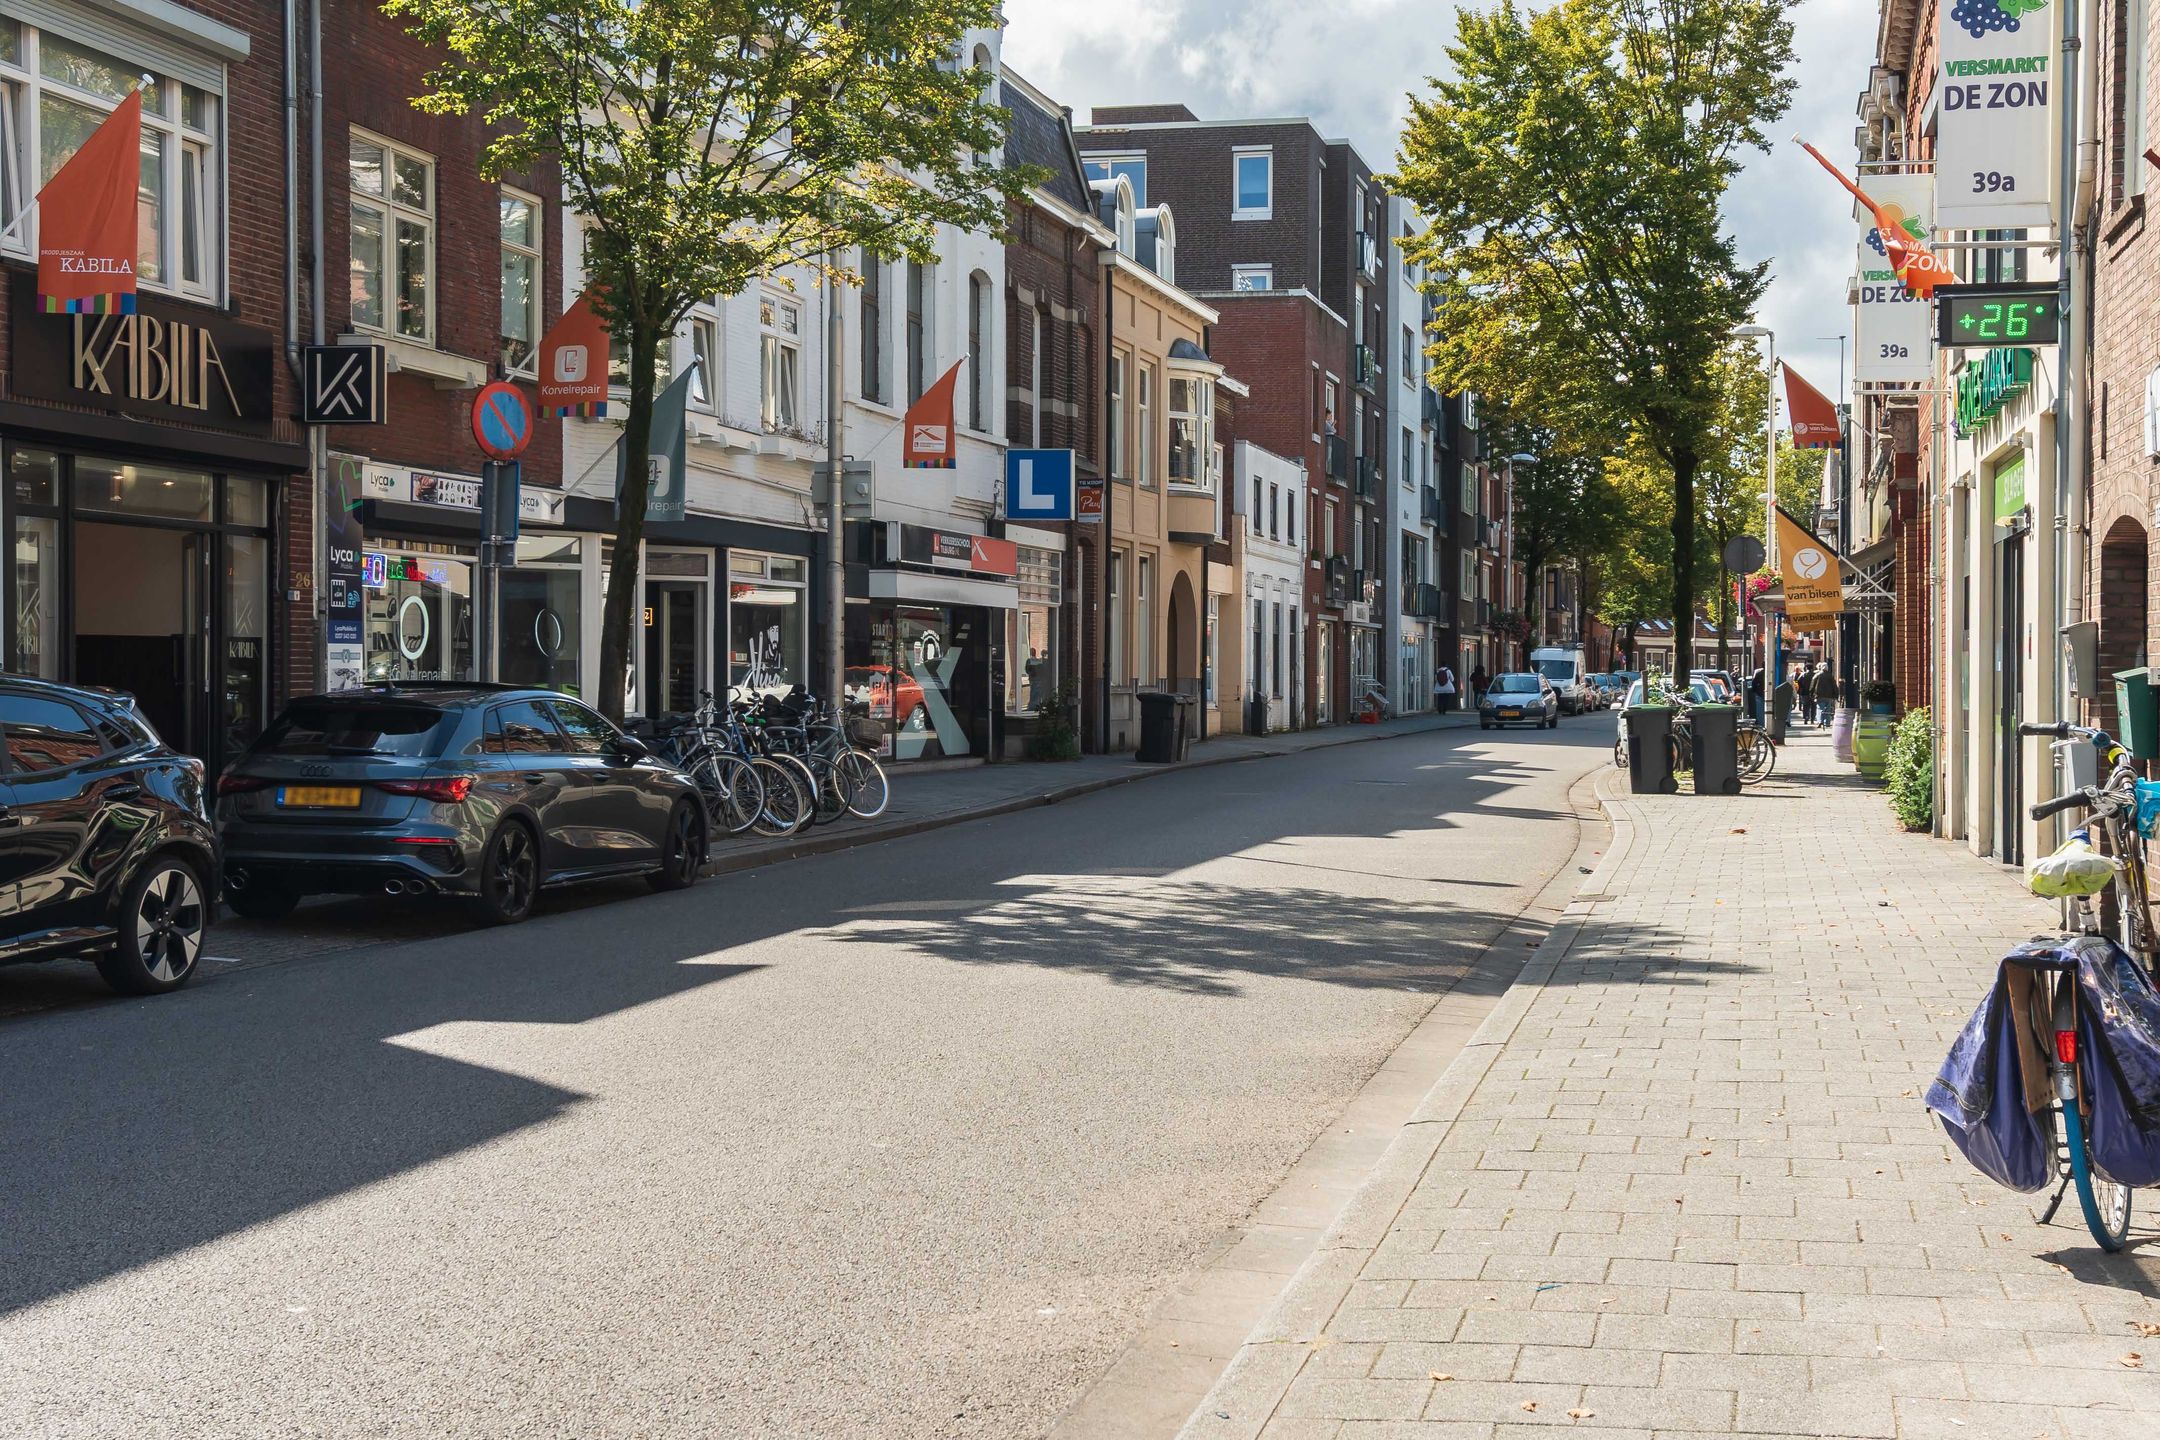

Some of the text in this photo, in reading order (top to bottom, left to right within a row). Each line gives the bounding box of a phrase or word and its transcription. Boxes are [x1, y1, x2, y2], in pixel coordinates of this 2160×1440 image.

[1945, 56, 2049, 77] VERSMARKT
[1944, 81, 2048, 111] DE ZON
[1972, 171, 2015, 193] 39a
[60, 257, 133, 274] KABILA
[1906, 252, 1948, 274] ZON
[1862, 287, 1886, 304] DE
[1880, 344, 1908, 358] 39a
[74, 313, 242, 417] KABILA
[541, 383, 601, 396] Korvelrepair
[370, 472, 389, 487] Lyca
[1019, 459, 1055, 510] L
[647, 500, 681, 514] lrepair
[331, 545, 353, 564] Lyca
[295, 572, 311, 588] 26
[1788, 589, 1840, 600] van bilsen
